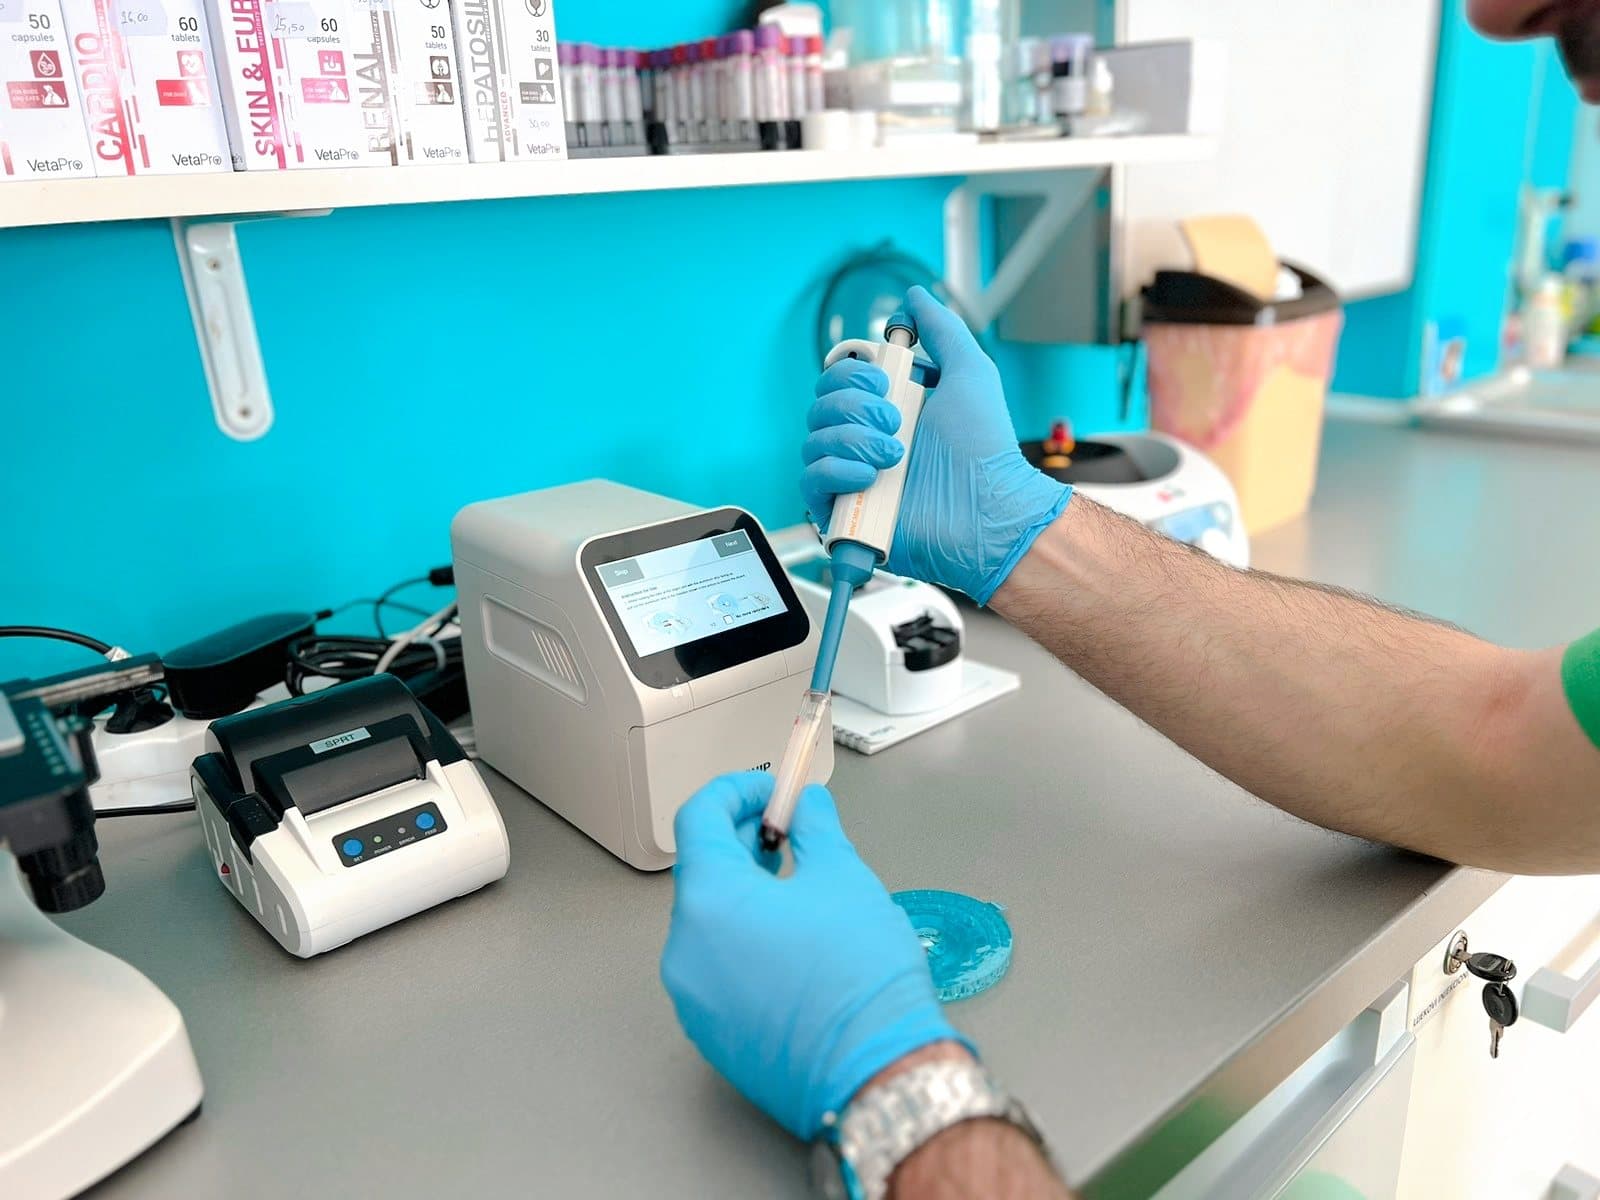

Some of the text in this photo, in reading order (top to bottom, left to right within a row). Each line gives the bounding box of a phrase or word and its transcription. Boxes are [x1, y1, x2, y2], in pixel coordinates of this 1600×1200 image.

[28, 14, 51, 29] 50
[178, 17, 198, 32] 60
[321, 18, 338, 32] 60
[11, 33, 55, 43] capsules
[171, 34, 200, 43] tablets
[307, 35, 341, 44] capsules
[431, 25, 446, 39] 50
[536, 30, 550, 42] 30
[425, 41, 448, 50] tablets
[242, 63, 265, 82] &
[74, 32, 123, 160] CARDIO
[353, 43, 391, 152] RENAL
[246, 91, 277, 156] SKIN
[500, 91, 512, 142] ADVANCED
[324, 732, 355, 749] SPRT
